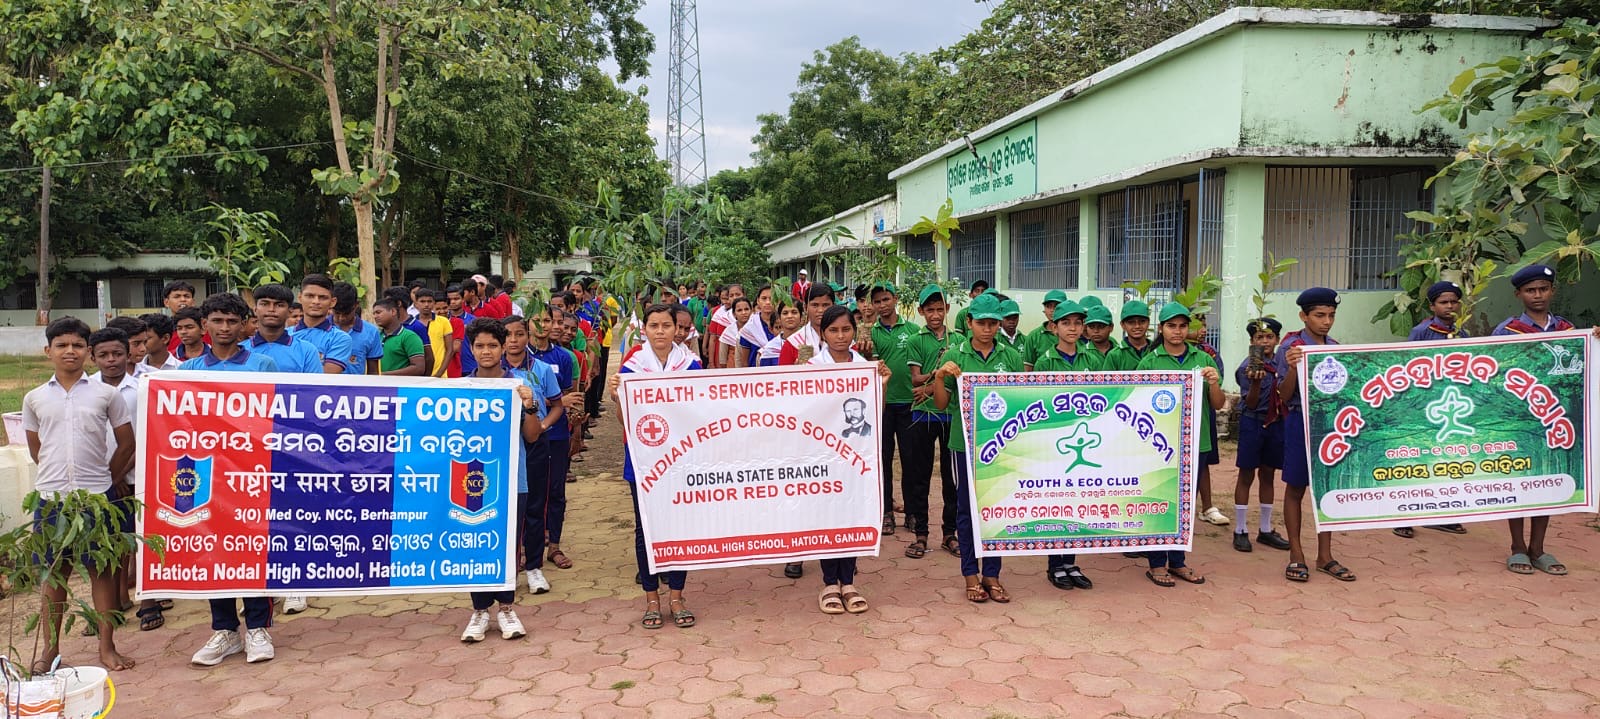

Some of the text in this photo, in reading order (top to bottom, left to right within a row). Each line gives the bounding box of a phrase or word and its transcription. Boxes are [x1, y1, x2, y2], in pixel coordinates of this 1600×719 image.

[633, 386, 694, 405] HEALTH
[709, 377, 870, 400] SERVICE-FRIENDSHIP
[1361, 353, 1497, 406] ମହୋତ୍ସବ
[156, 390, 505, 422] NATIONAL CADET CORPS
[980, 401, 1048, 463] ଜାତୀୟ
[1053, 392, 1107, 415] ସବୁଜ
[168, 430, 253, 452] ଜାତୀୟ
[262, 432, 326, 453] ସମର
[420, 429, 492, 457] ବାହିନୀ
[641, 437, 694, 493] INDIAN
[696, 418, 732, 443] RED
[737, 412, 797, 431] CROSS
[802, 421, 872, 477] SOCIETY
[686, 465, 829, 487] ODISHA STATE BRANCH
[1373, 455, 1532, 480] ଜାତୀୟ ସବୁଜ ବାହିନୀ
[177, 477, 195, 487] NCC
[224, 464, 440, 498] राष्ट्रीय समर छात्र सेना
[467, 479, 484, 488] NCC
[672, 480, 843, 505] JUNIOR RED CROSS
[1018, 477, 1139, 489] YOUTH & ECO CLUB
[265, 508, 292, 521] Med
[296, 508, 321, 523] Coy.
[325, 509, 357, 523] NCC,
[361, 508, 428, 522] Berhampur
[155, 534, 217, 552] ାତୀଓଟ
[372, 532, 433, 551] ହାତୀଓଟ
[687, 544, 719, 555] NODAL
[721, 542, 745, 553] HIGH
[747, 538, 790, 550] SCHOOL,
[834, 531, 874, 544] GANJAM
[150, 563, 208, 581] Hatiota
[213, 563, 260, 580] Nodal
[266, 562, 301, 584] High
[306, 562, 364, 582] School,
[369, 561, 426, 579] Hatiota
